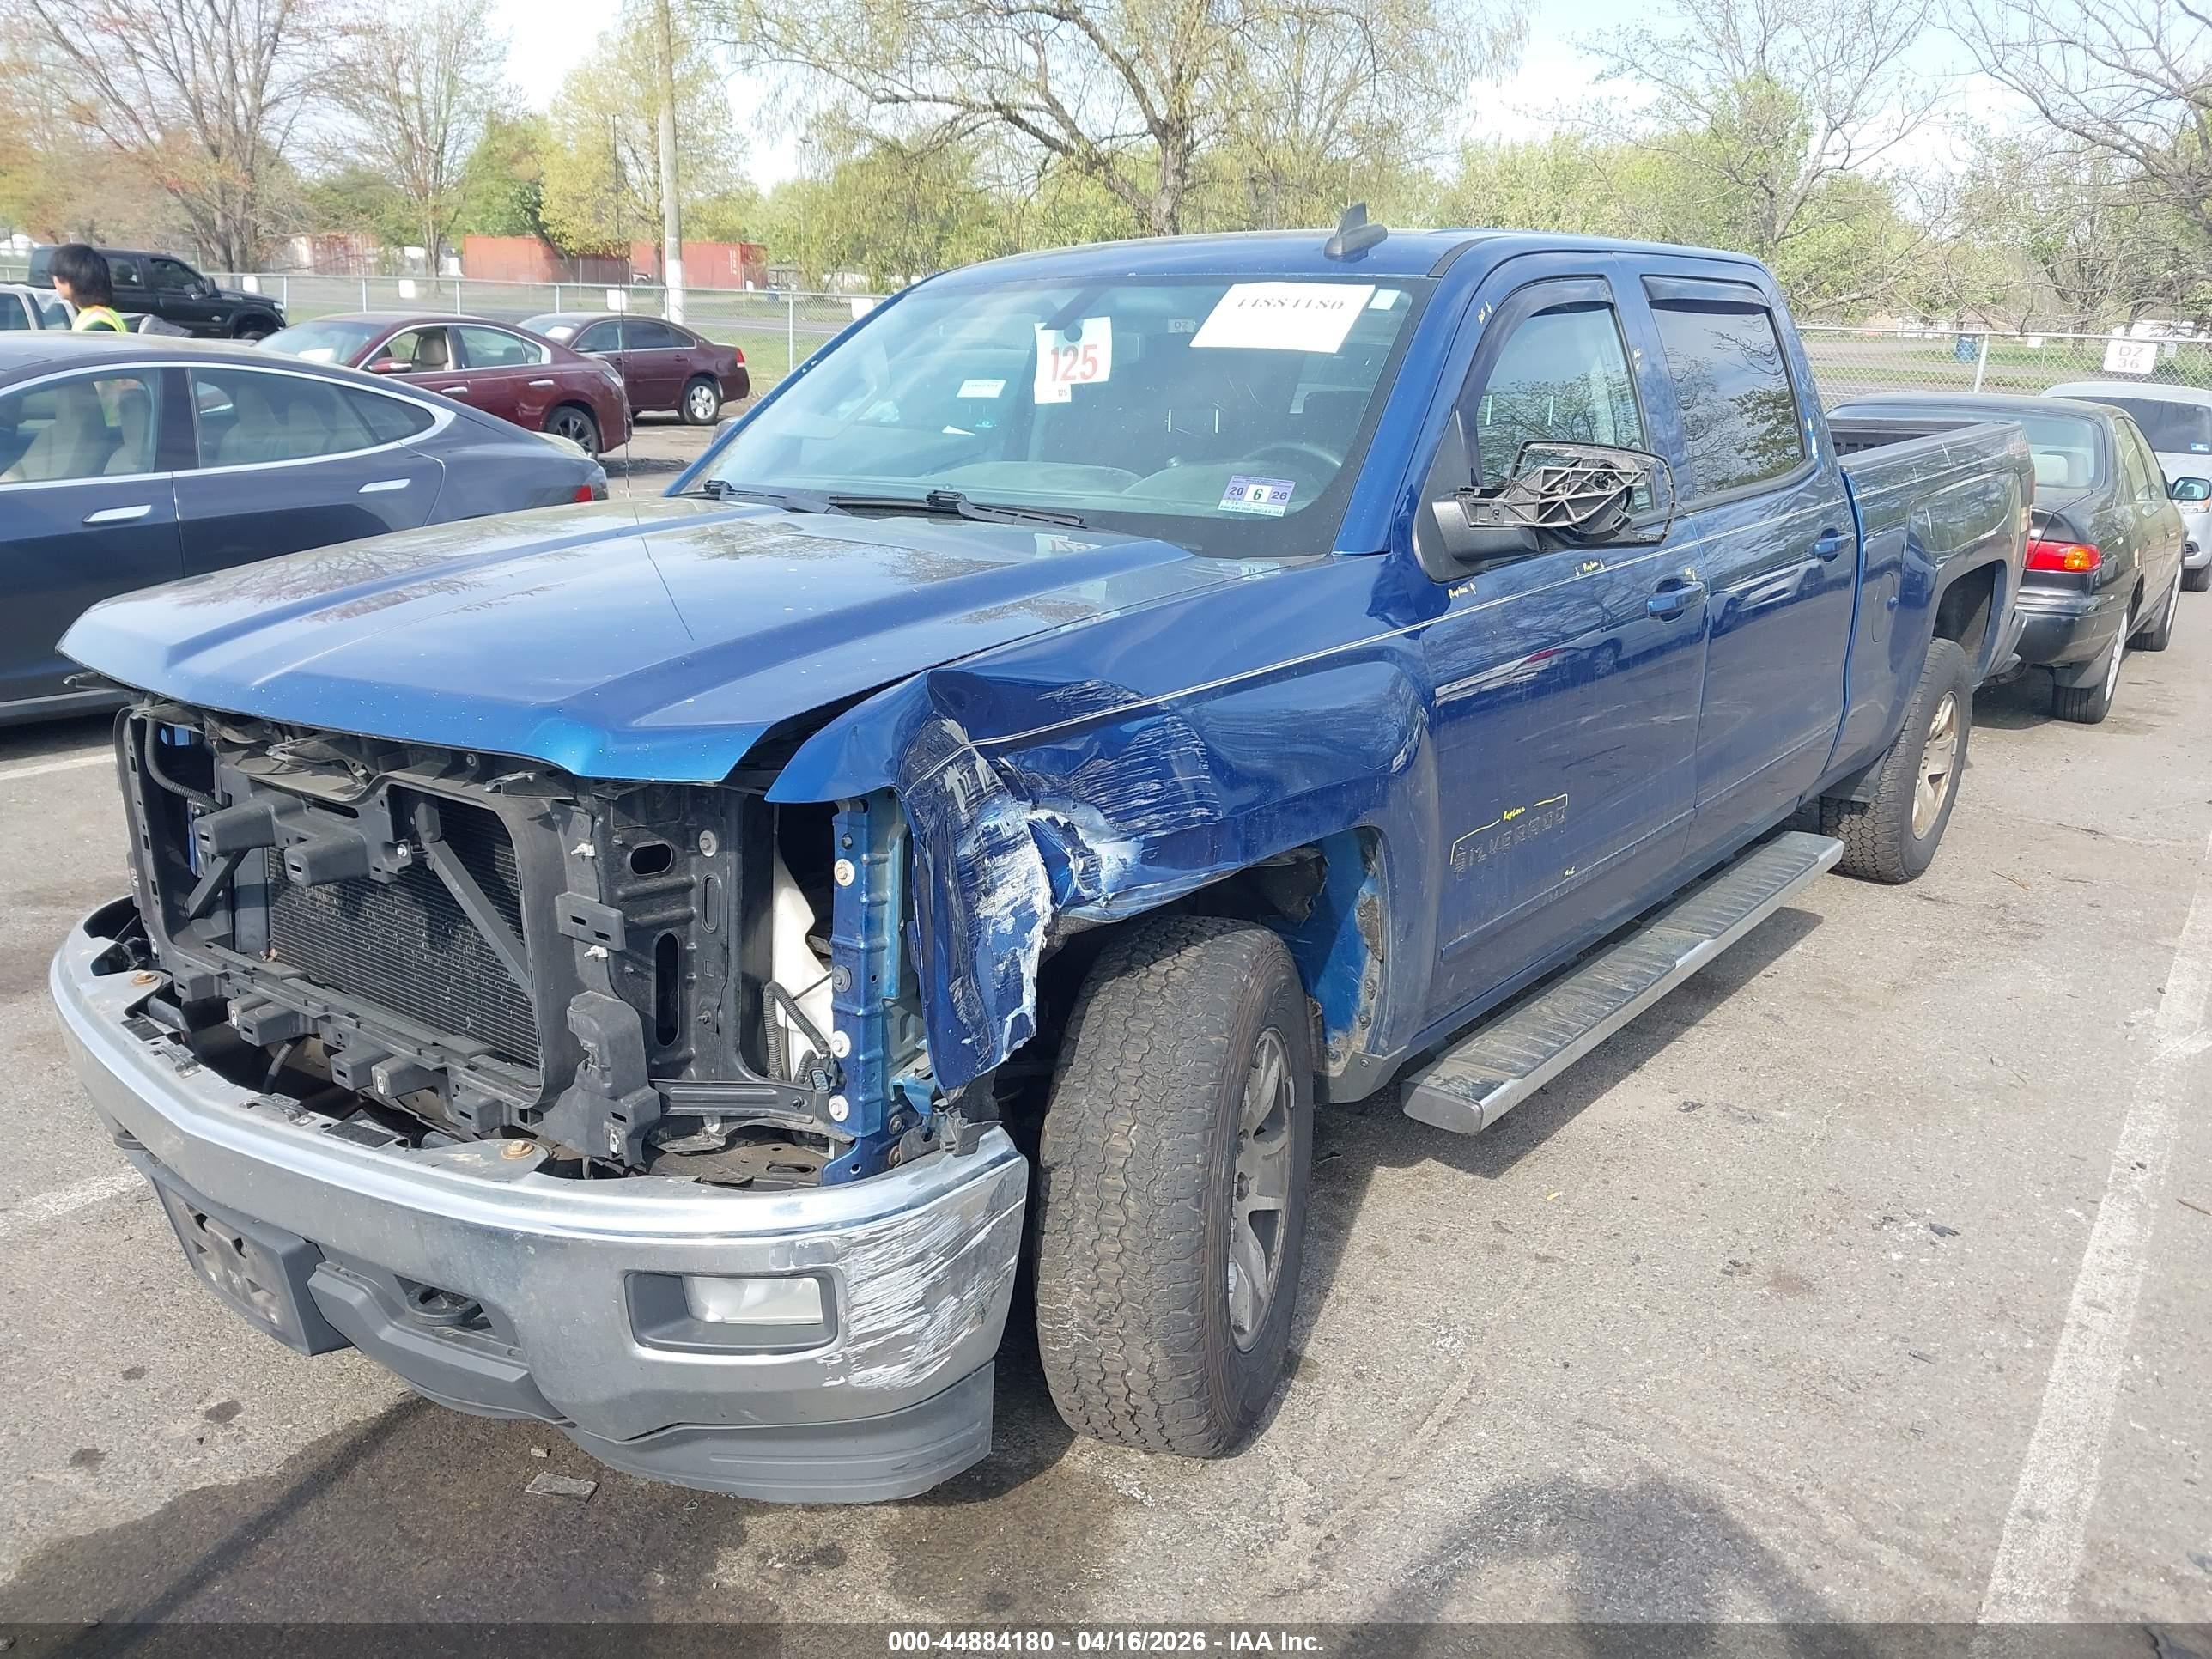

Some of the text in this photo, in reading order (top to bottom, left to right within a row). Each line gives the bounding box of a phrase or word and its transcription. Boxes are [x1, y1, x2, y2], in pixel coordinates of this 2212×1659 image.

[2119, 346, 2144, 357] DZ
[1050, 343, 1098, 382] 125
[2118, 358, 2140, 369] 36
[1254, 489, 1264, 500] 6
[1272, 491, 1287, 500] 26
